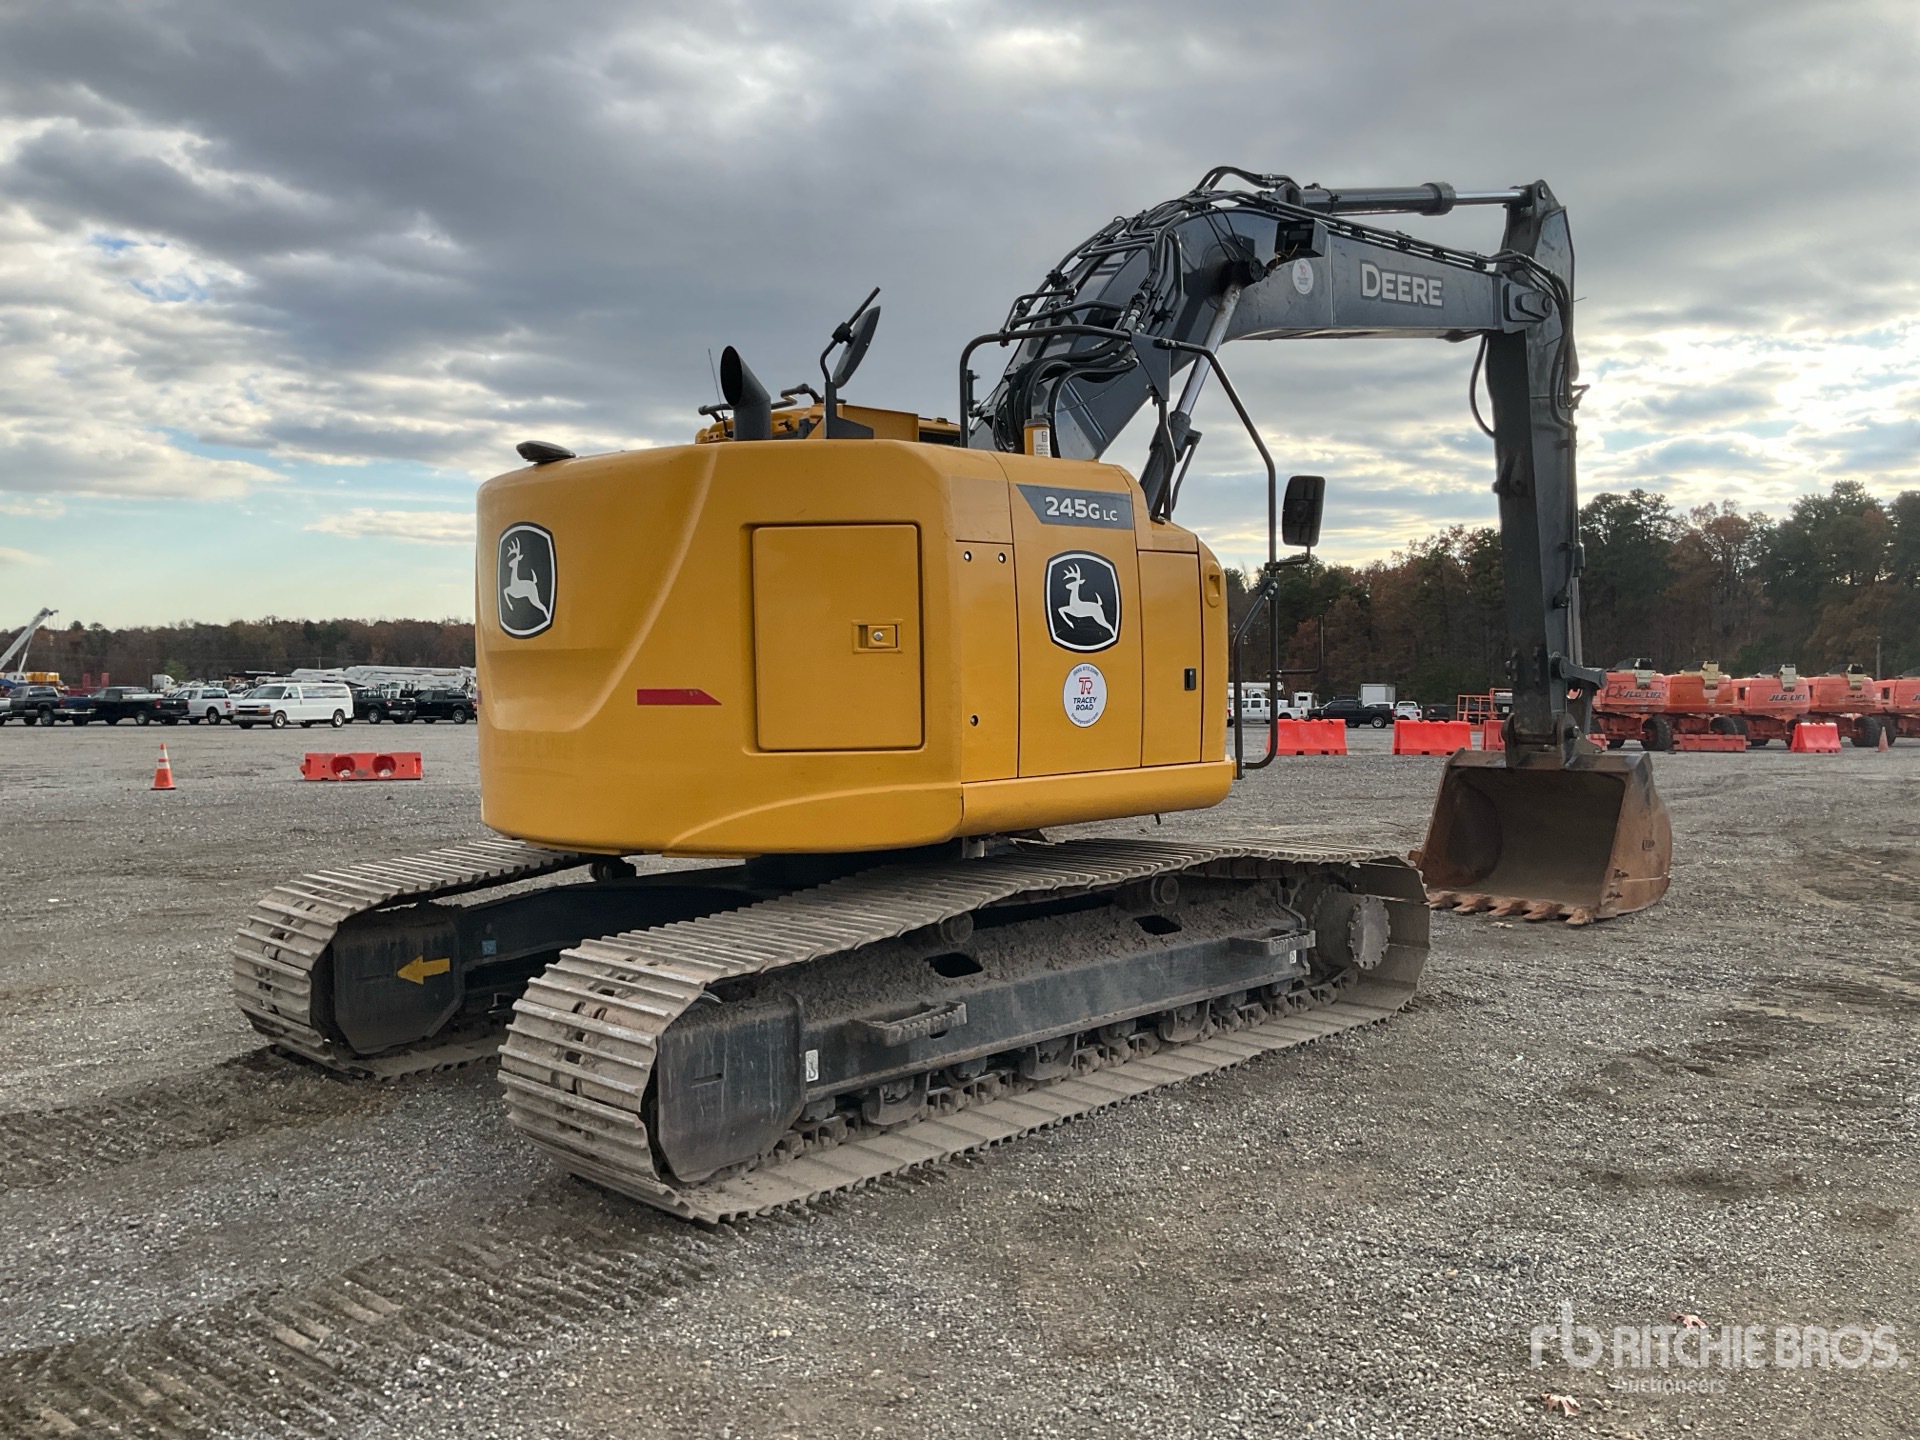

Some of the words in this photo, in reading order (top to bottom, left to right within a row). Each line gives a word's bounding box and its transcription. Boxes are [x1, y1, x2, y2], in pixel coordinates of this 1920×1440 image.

[1361, 263, 1443, 307] DEERE
[1045, 495, 1101, 520] 245G
[1102, 509, 1118, 522] LC
[1073, 696, 1097, 704] TRACEY
